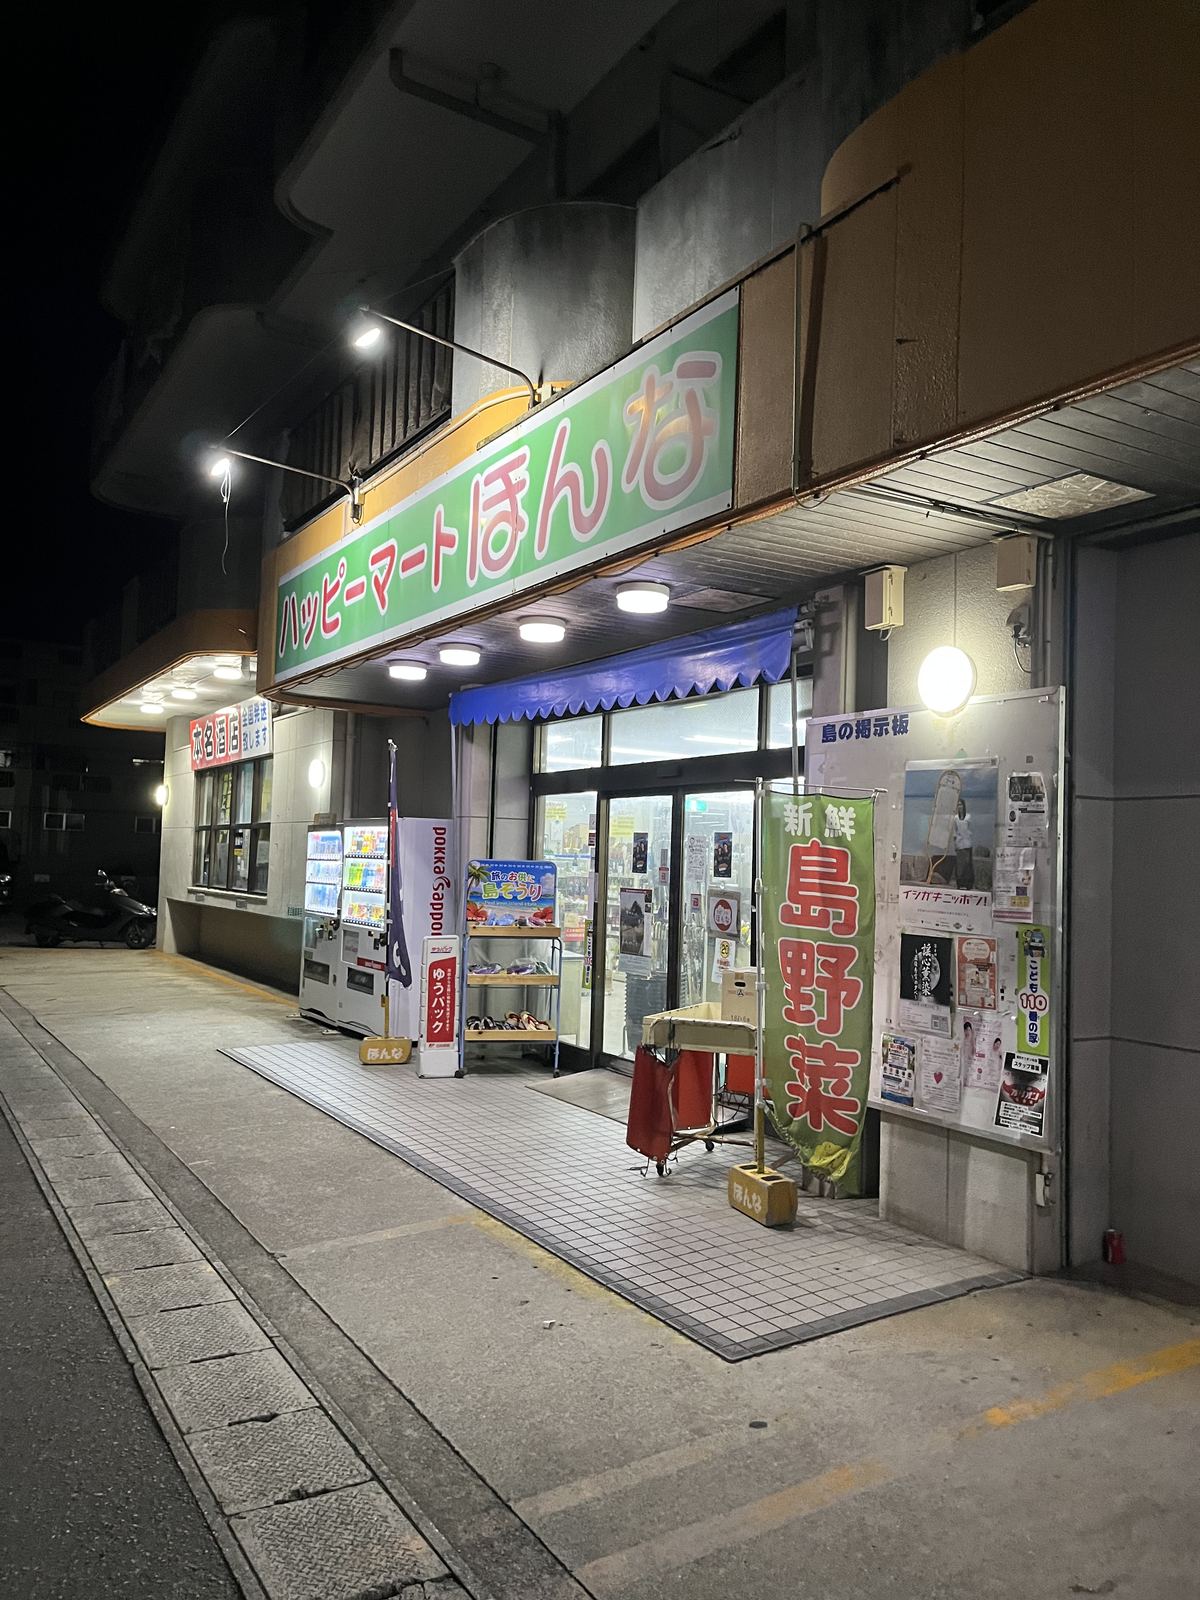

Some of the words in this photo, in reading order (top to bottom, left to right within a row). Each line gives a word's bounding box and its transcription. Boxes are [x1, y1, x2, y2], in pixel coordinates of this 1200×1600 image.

[279, 505, 457, 657] ハッピーマート
[468, 353, 721, 585] ほんな
[821, 714, 909, 743] 島の掲示板
[783, 801, 857, 842] 新鮮
[432, 968, 446, 1034] ゆうパック
[778, 838, 862, 1138] 島野菜
[367, 1047, 404, 1060] ほんな
